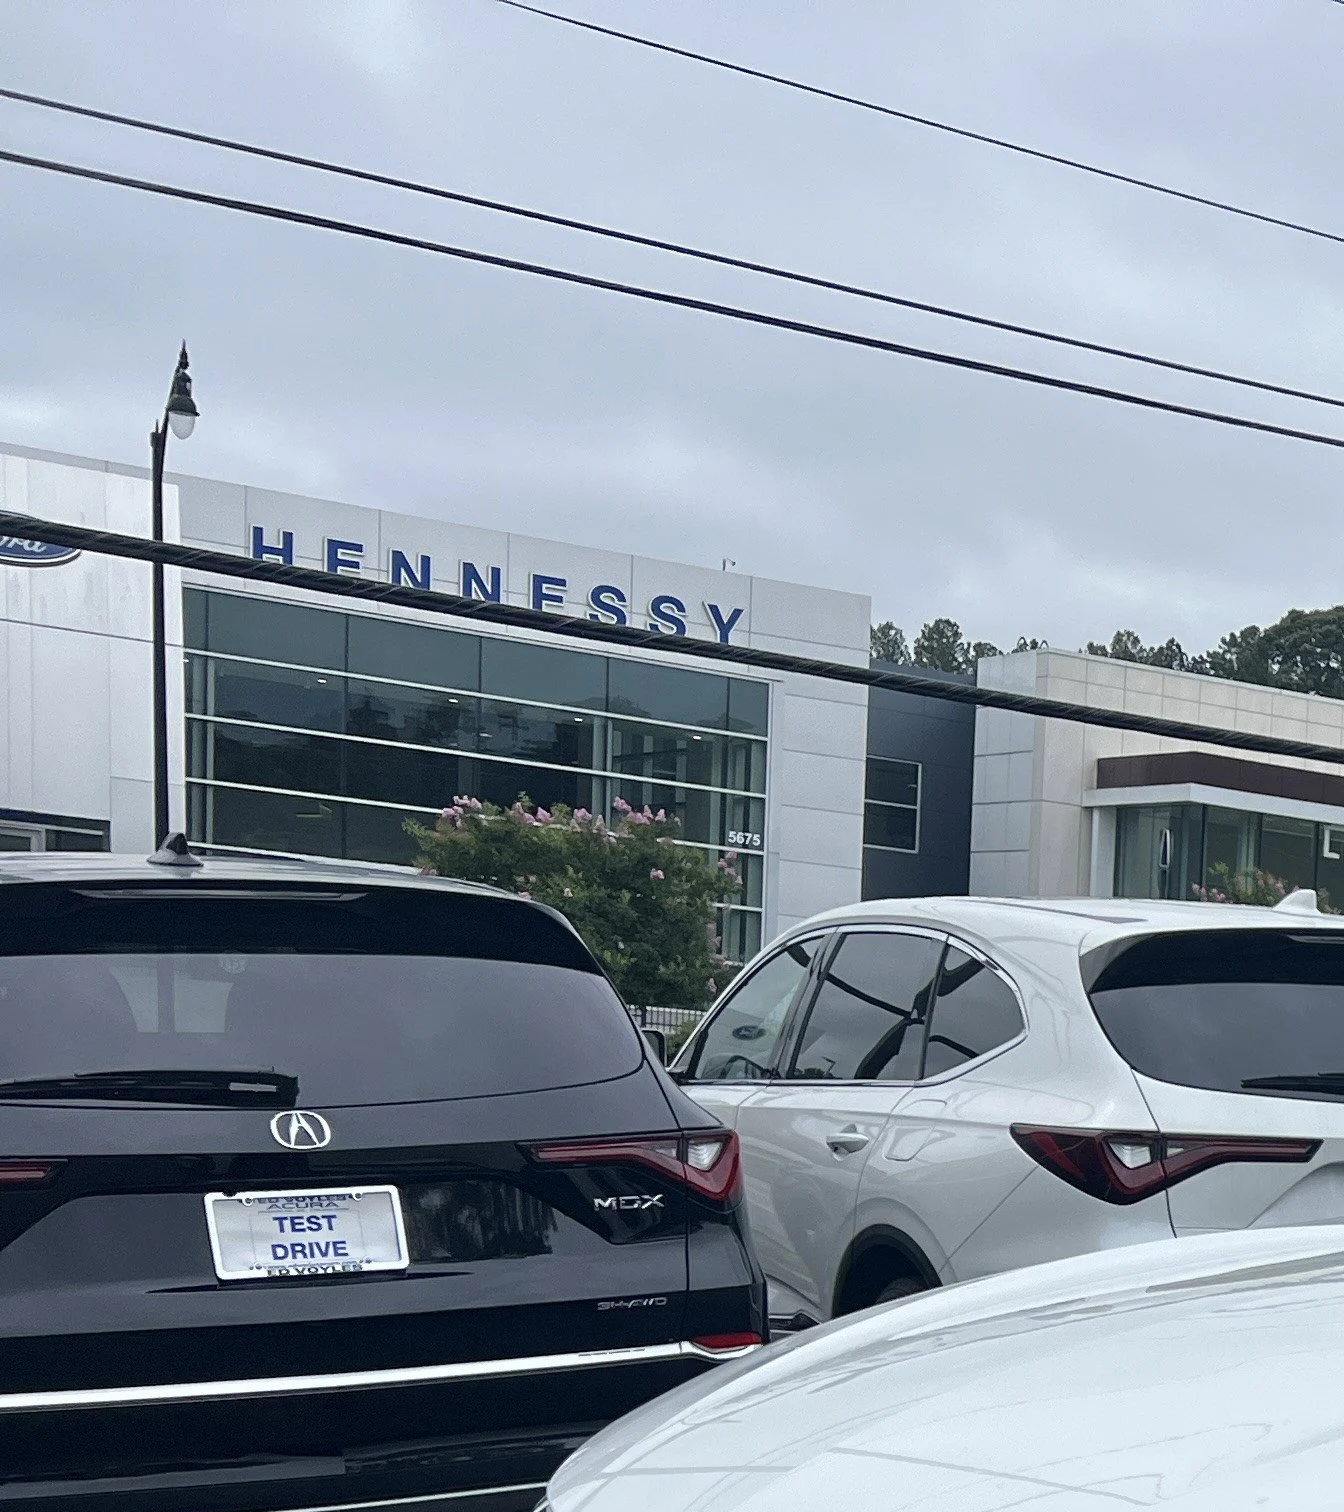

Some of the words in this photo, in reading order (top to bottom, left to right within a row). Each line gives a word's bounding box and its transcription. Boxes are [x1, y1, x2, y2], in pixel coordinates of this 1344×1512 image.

[250, 524, 746, 646] HENNESSY
[728, 830, 760, 846] 5675
[267, 1201, 340, 1209] ACURA
[593, 1194, 664, 1211] MDX
[272, 1214, 337, 1233] TEST
[271, 1240, 349, 1260] DRIVE
